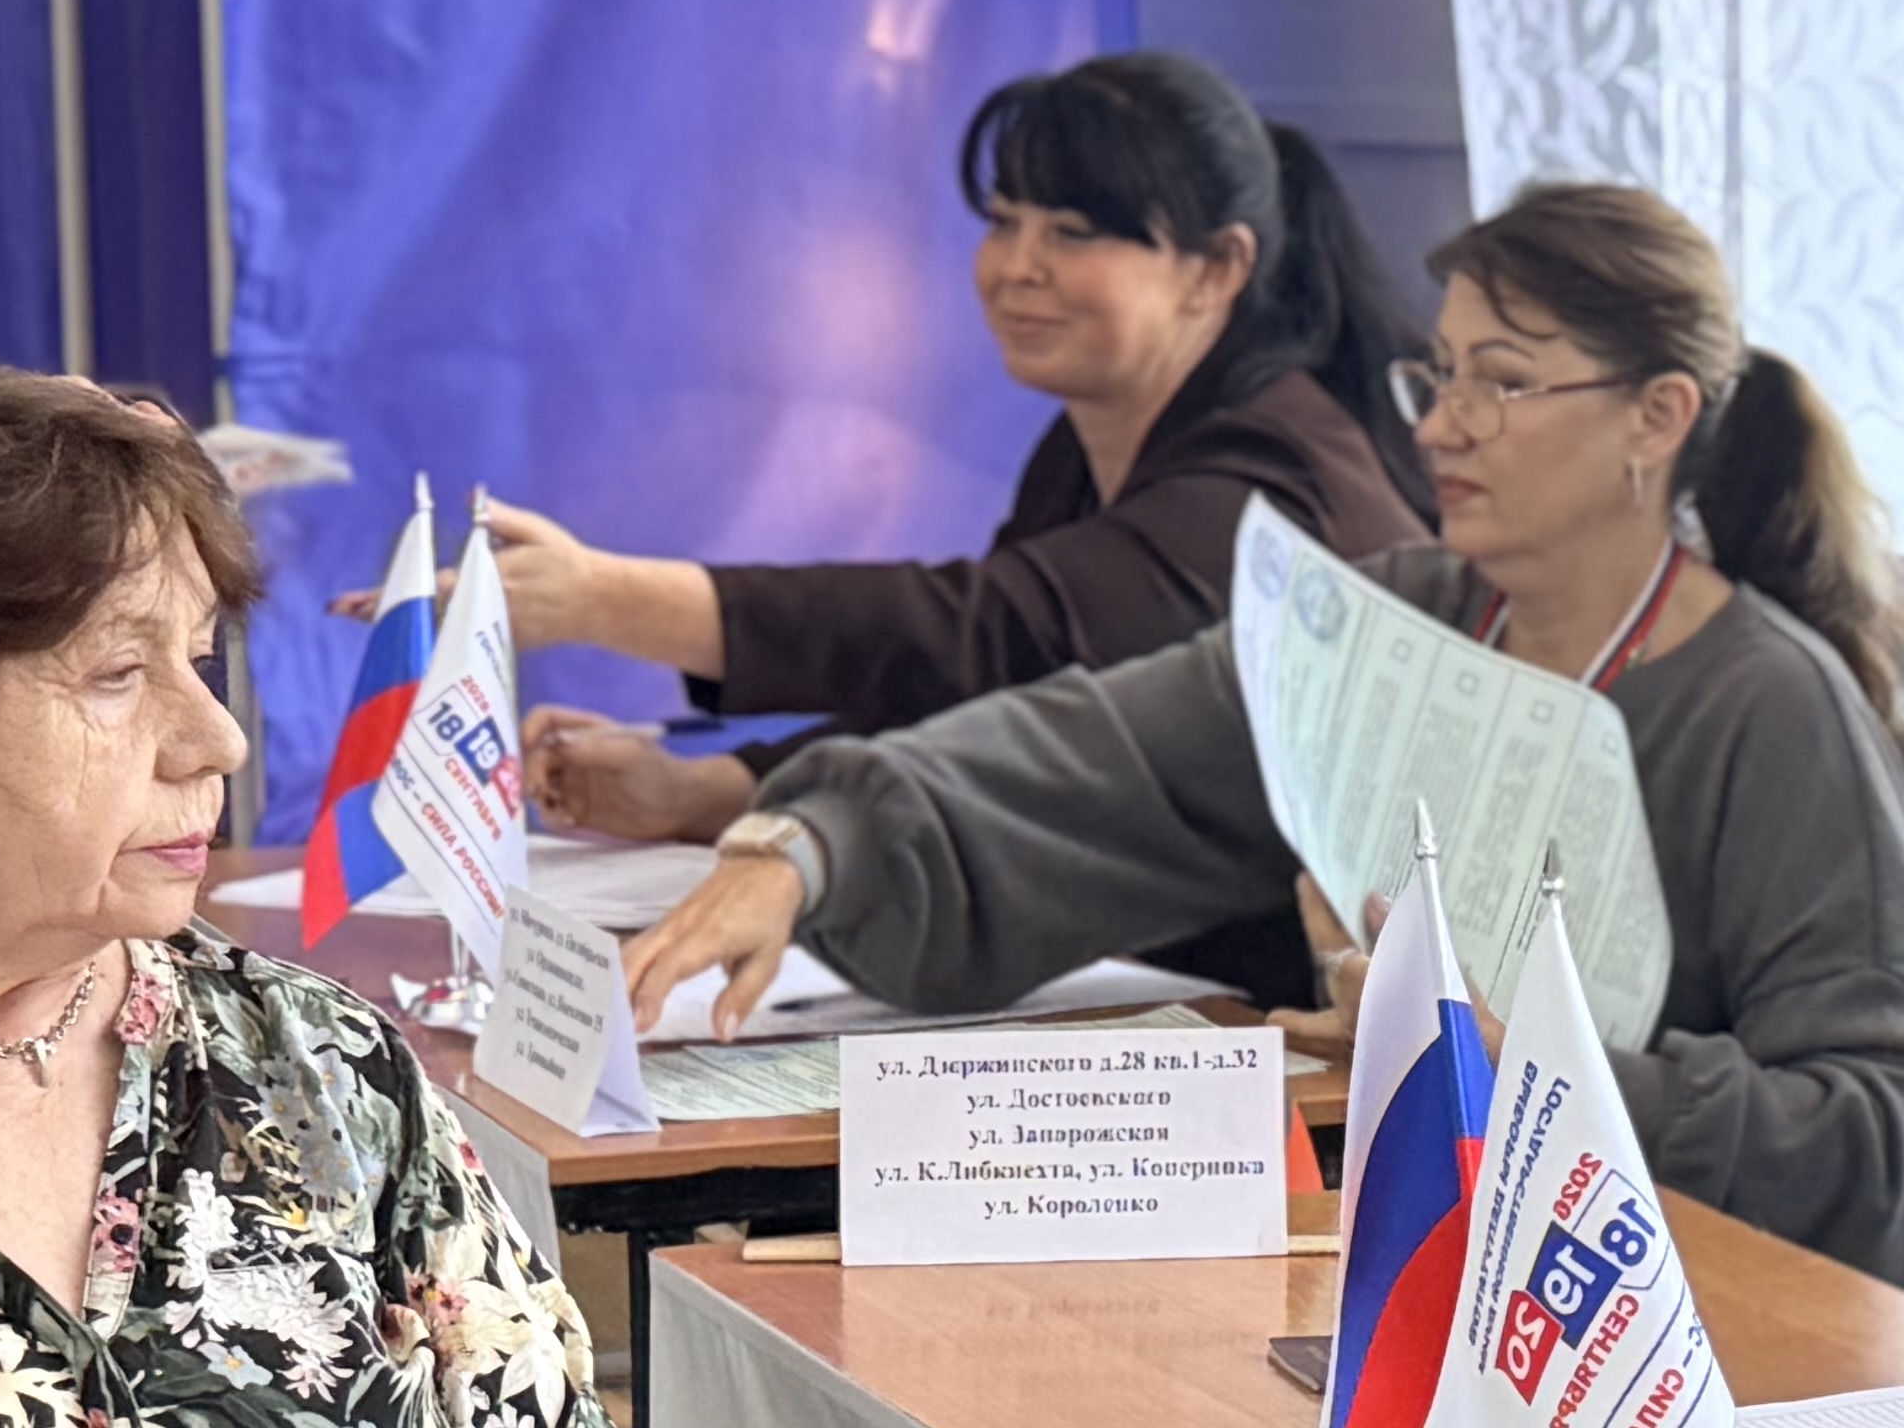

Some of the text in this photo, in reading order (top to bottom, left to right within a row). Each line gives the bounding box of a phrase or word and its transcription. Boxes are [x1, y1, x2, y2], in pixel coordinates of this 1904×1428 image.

[428, 700, 501, 770] 18 19
[421, 802, 457, 849] СИЛА
[876, 1061, 912, 1081] ул.
[1099, 1051, 1146, 1072] д.28
[966, 1088, 1171, 1115] ул. Достоевского
[968, 1129, 1004, 1150] ул.
[874, 1166, 909, 1187] ул.
[1088, 1163, 1124, 1183] ул.
[984, 1194, 1160, 1221] ул. Короленко
